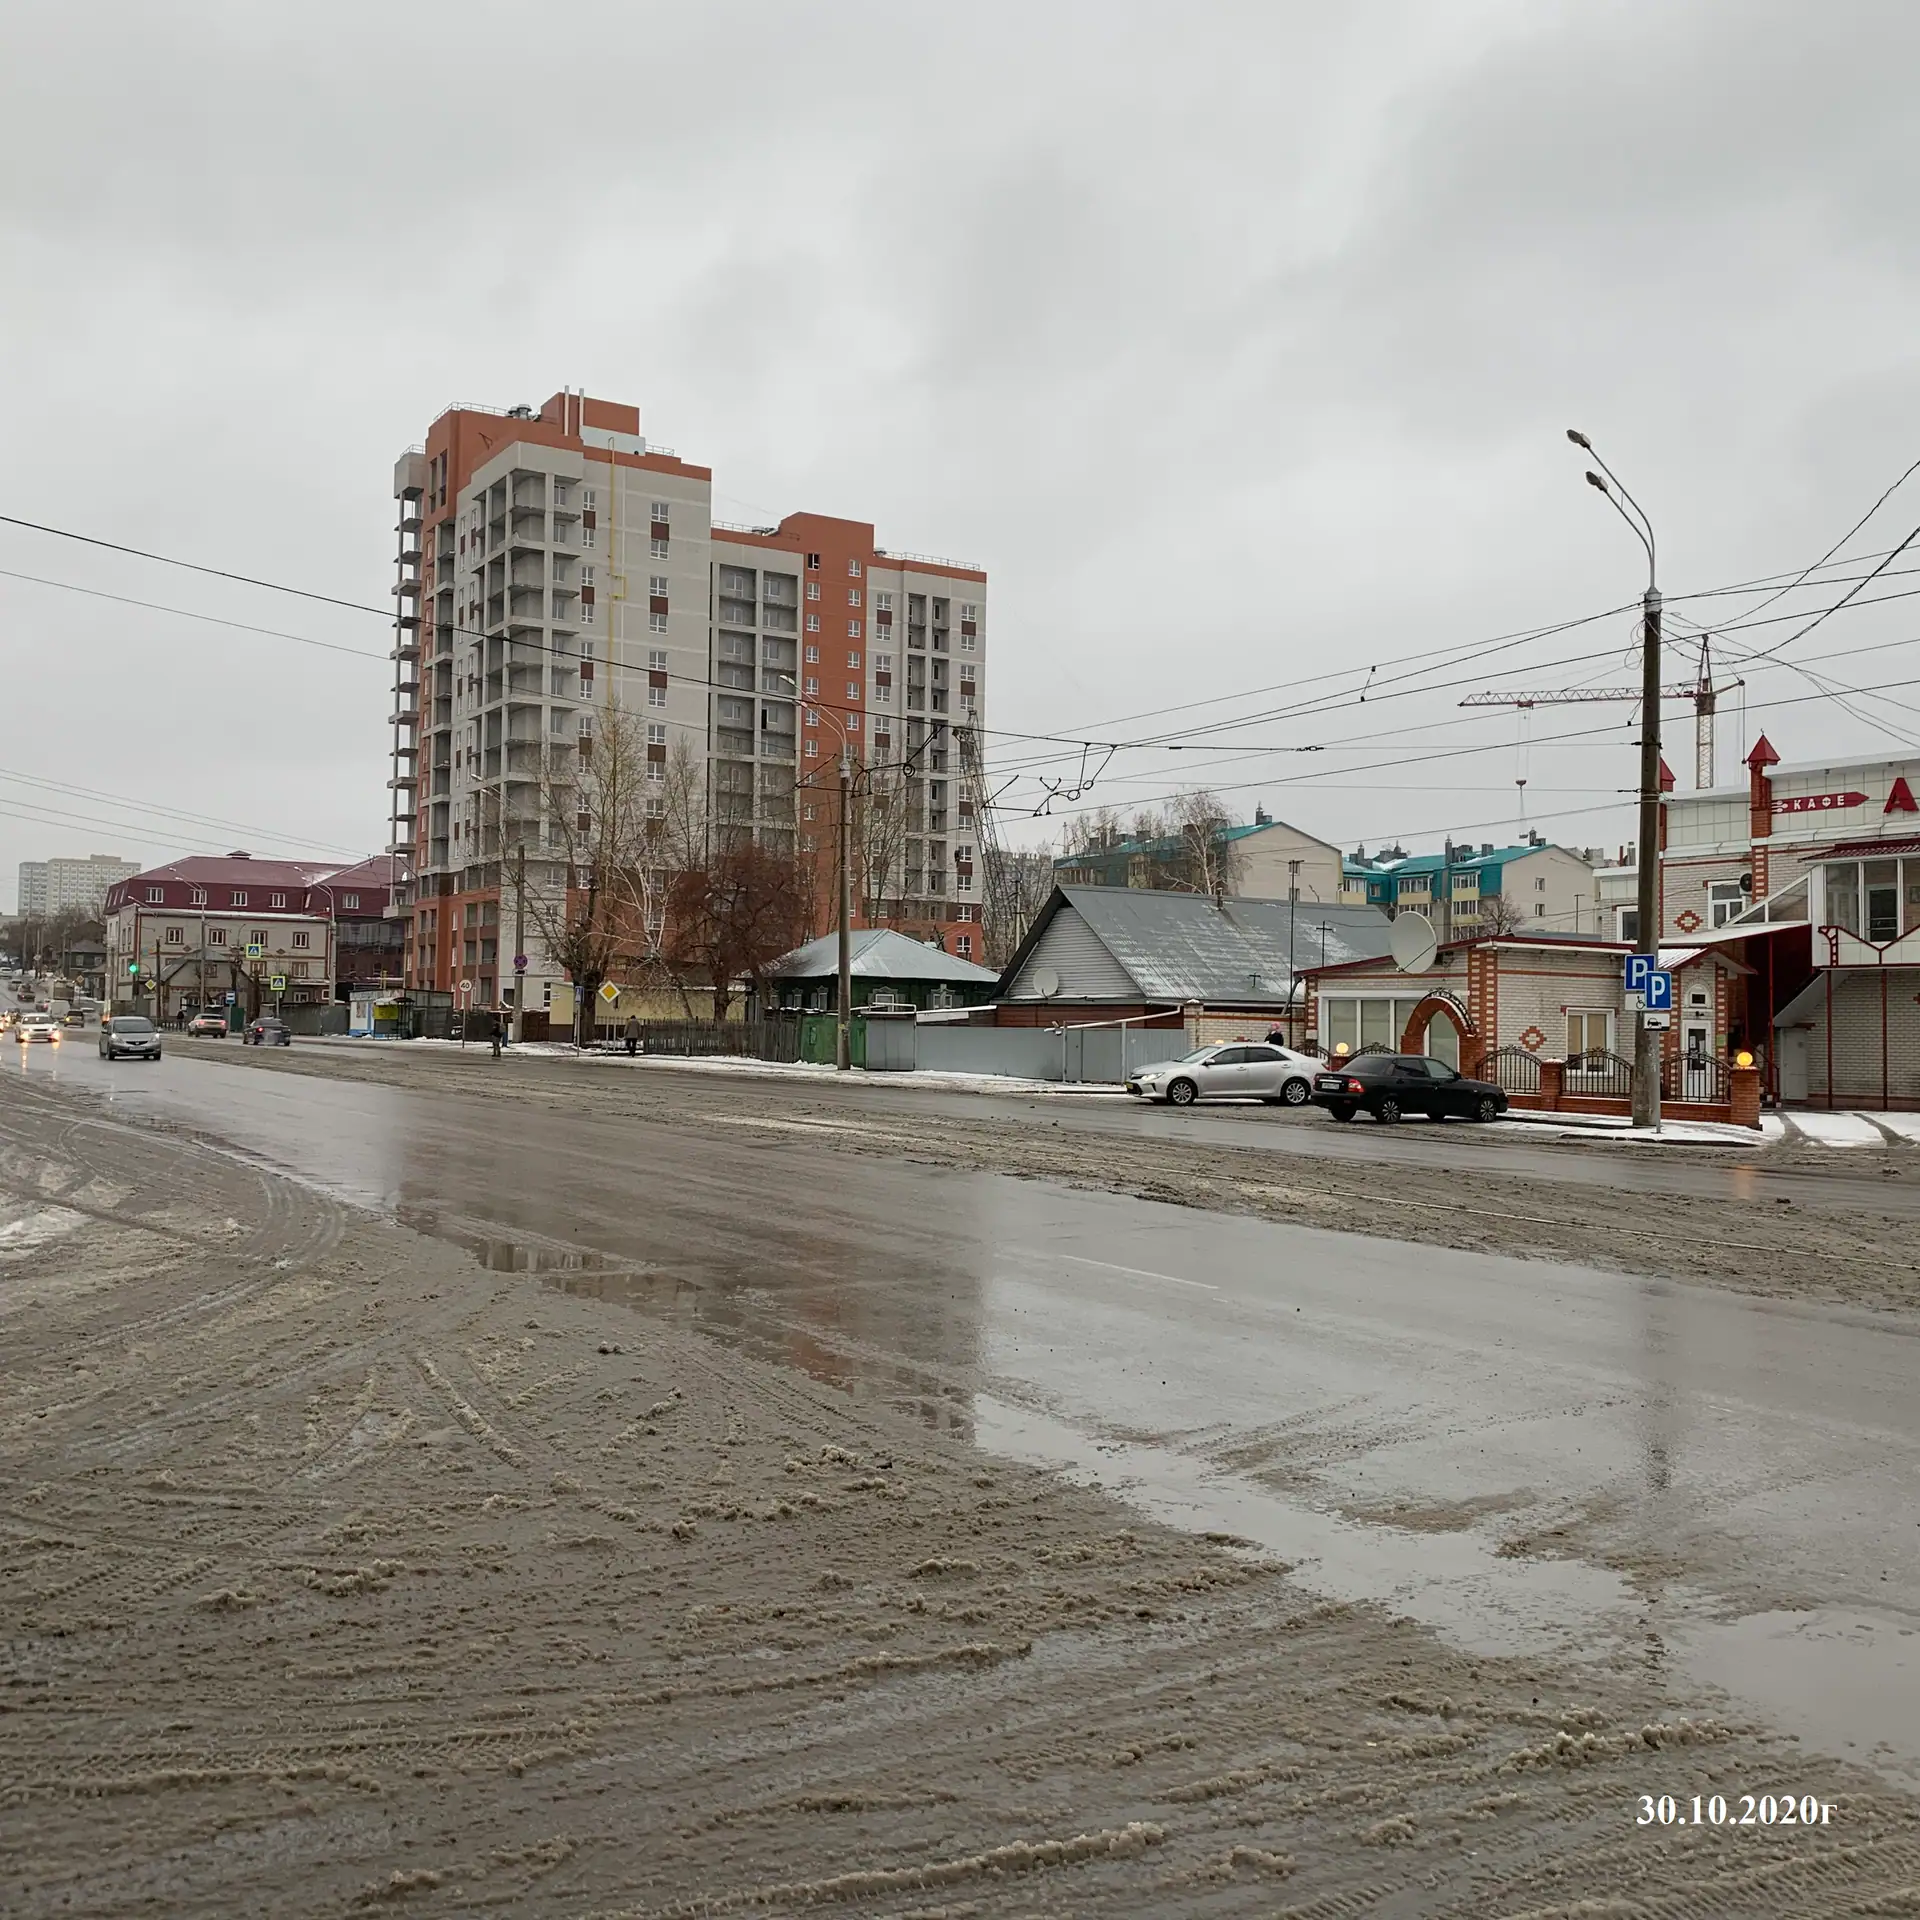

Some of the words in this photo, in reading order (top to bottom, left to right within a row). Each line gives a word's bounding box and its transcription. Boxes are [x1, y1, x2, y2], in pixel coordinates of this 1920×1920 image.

[1793, 795, 1845, 810] КАФЕ
[1631, 958, 1648, 987] P
[1651, 975, 1666, 1005] P
